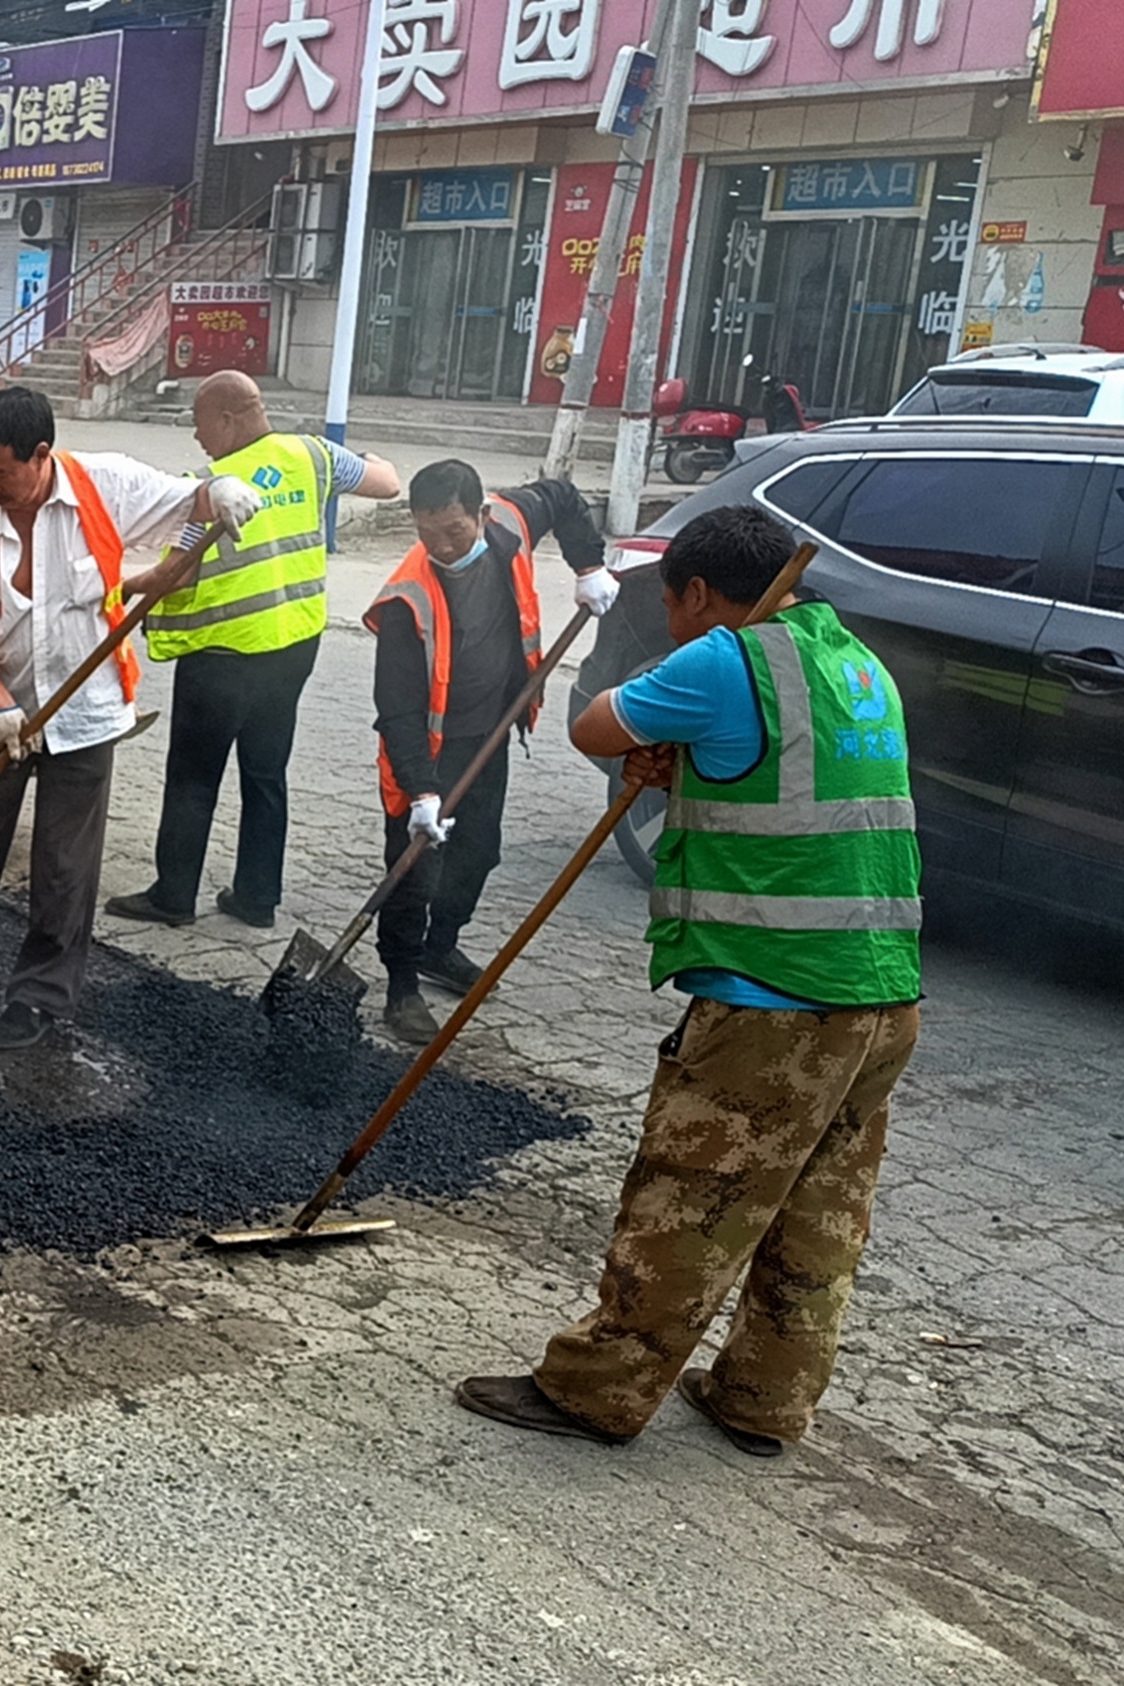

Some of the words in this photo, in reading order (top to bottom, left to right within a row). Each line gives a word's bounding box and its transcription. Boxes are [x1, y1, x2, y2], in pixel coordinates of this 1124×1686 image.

[421, 181, 511, 215] 超市入口
[788, 161, 916, 202] 超市入口
